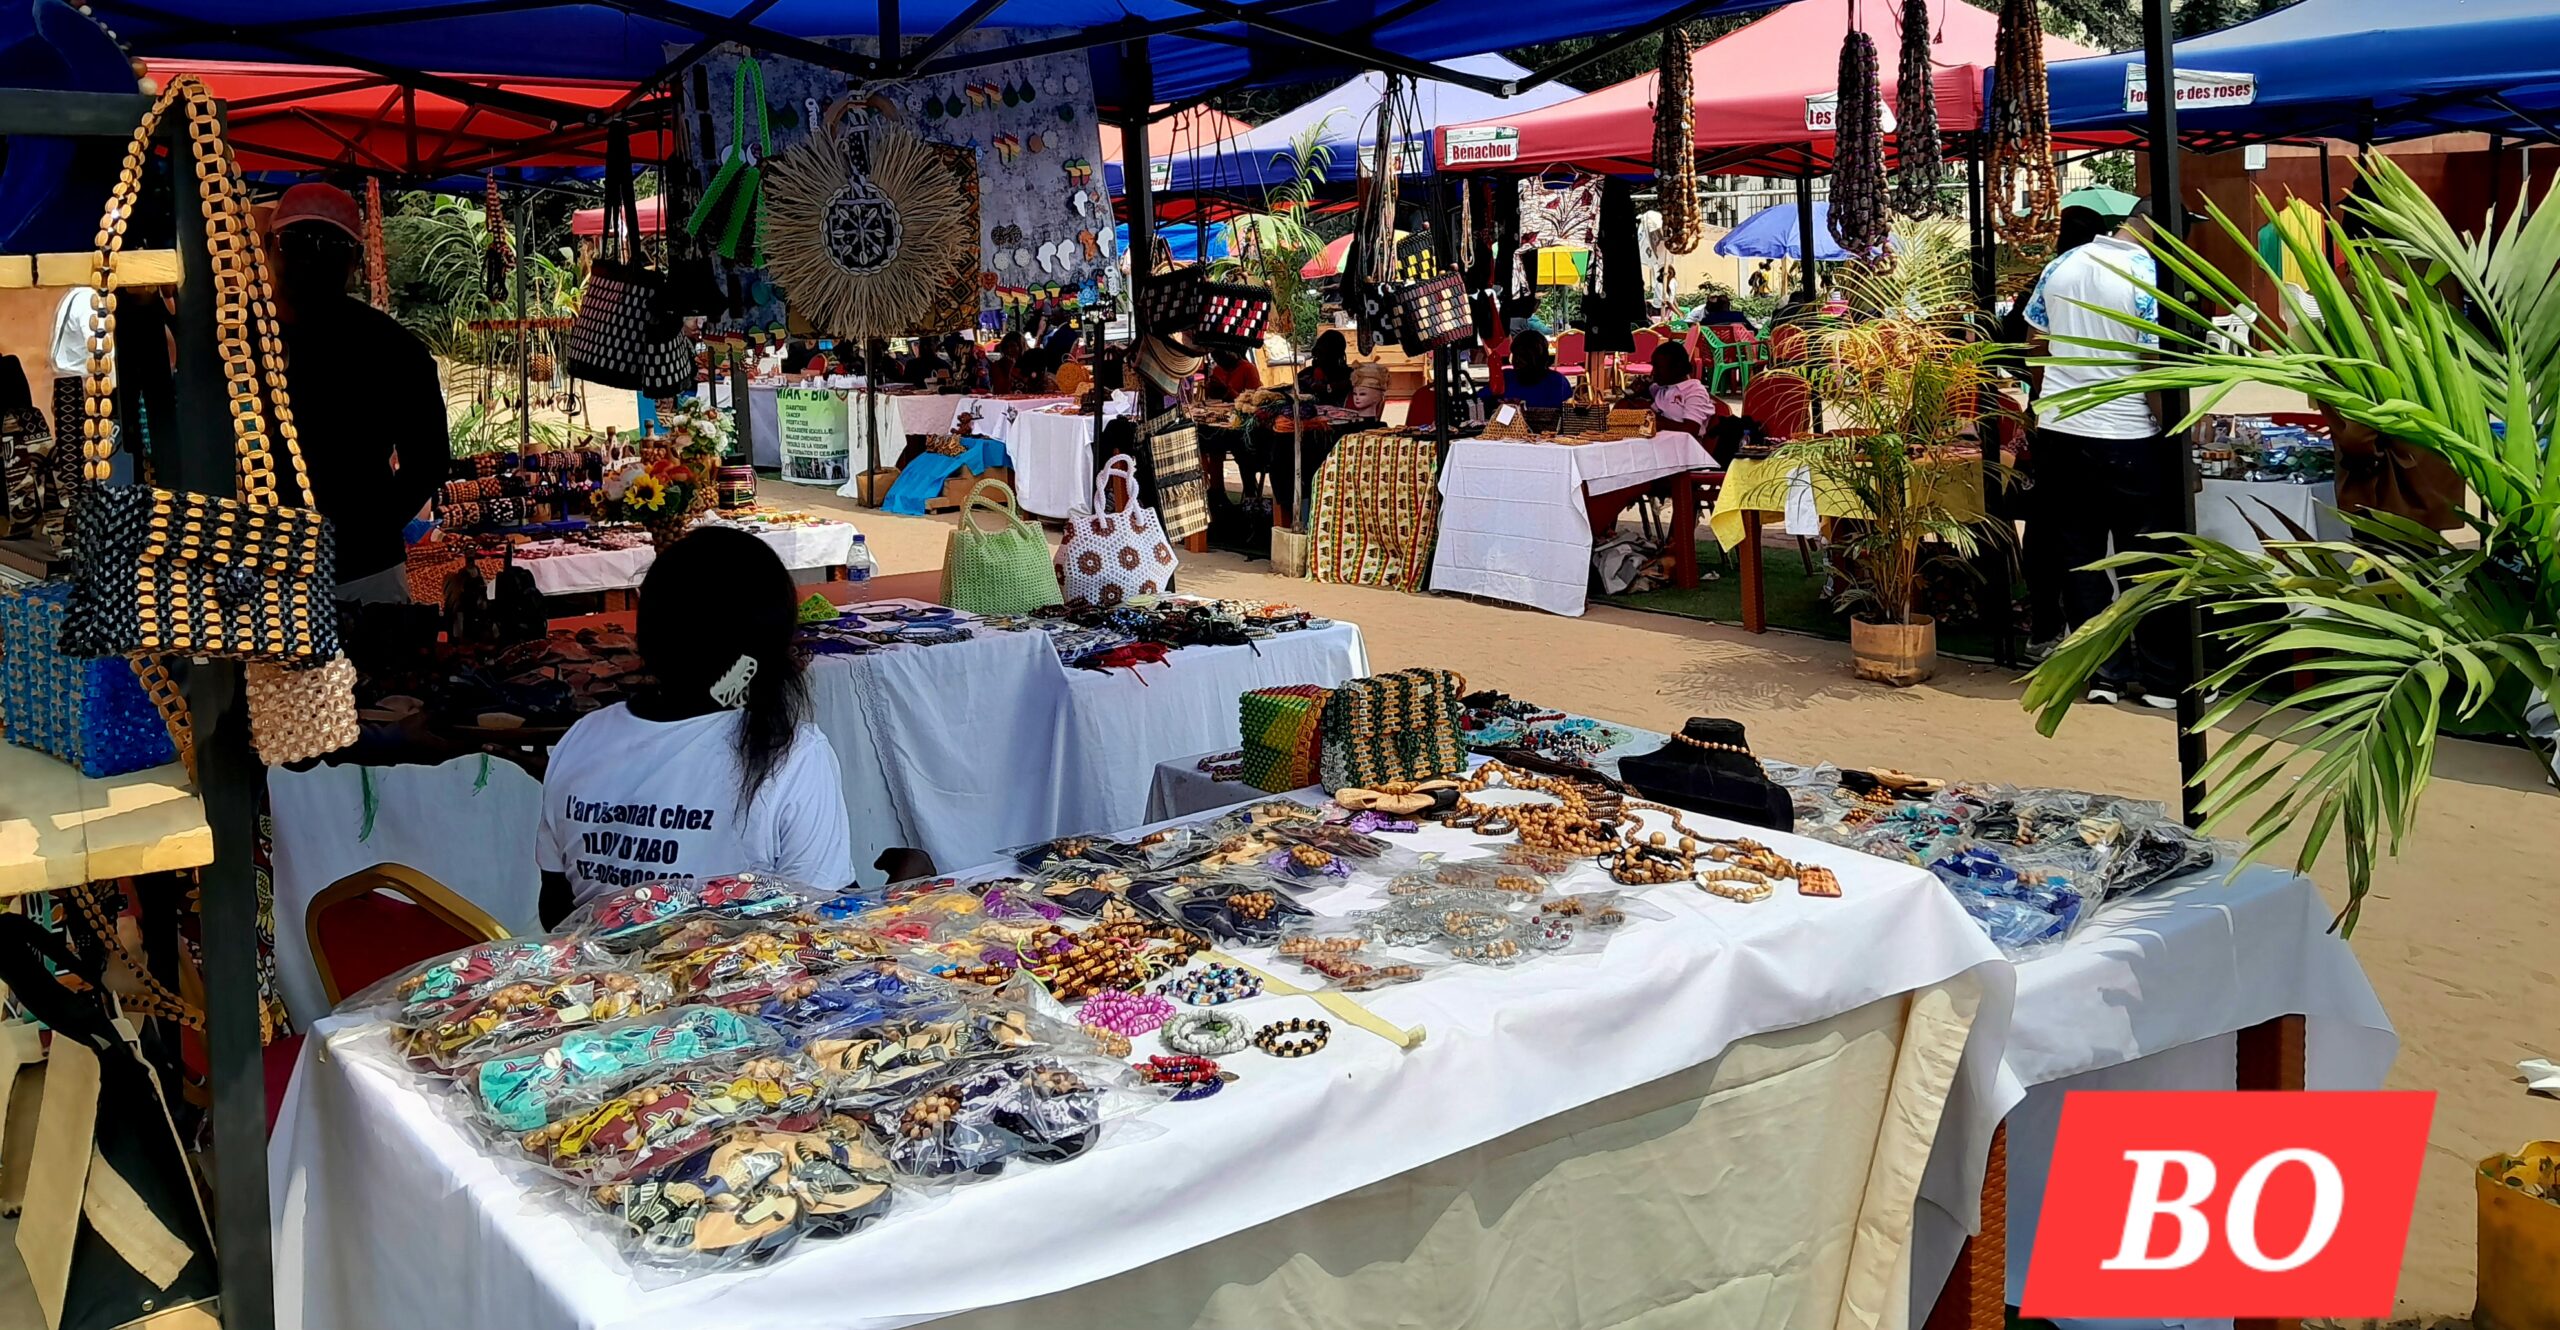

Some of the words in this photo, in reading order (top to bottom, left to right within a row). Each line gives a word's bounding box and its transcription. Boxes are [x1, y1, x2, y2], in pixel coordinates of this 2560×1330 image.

[2187, 86, 2210, 100] des
[2214, 83, 2251, 98] roses
[1452, 142, 1511, 161] Bénachou
[659, 804, 715, 831] chez
